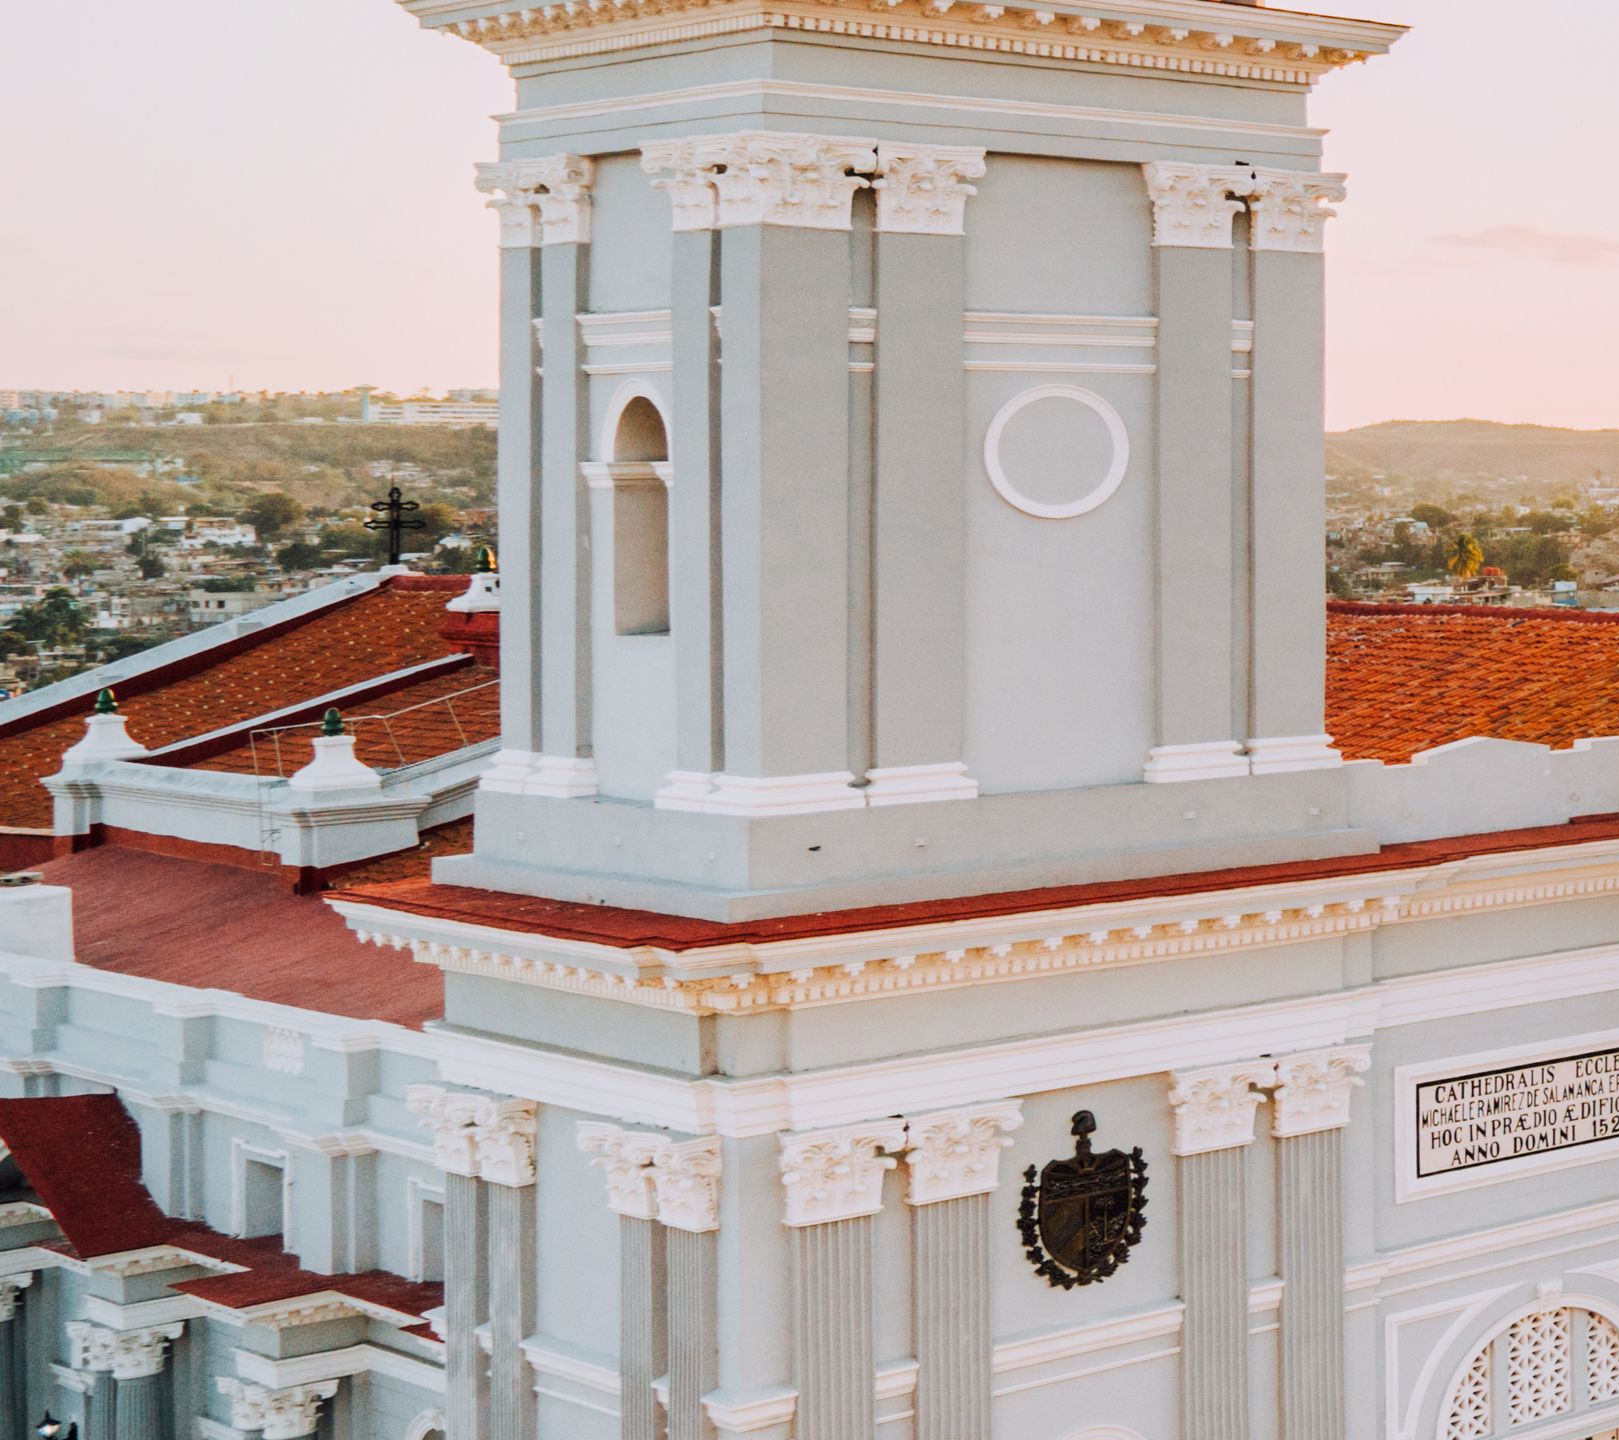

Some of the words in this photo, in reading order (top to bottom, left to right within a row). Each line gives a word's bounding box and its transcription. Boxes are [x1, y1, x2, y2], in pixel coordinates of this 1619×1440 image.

[1435, 1066, 1555, 1104] CATHEDRALIS
[1543, 1079, 1604, 1105] SALAMANCA
[1431, 1126, 1463, 1150] HOC
[1469, 1121, 1487, 1142] IN
[1451, 1141, 1500, 1167] ANNO
[1513, 1125, 1576, 1154] DOMINI
